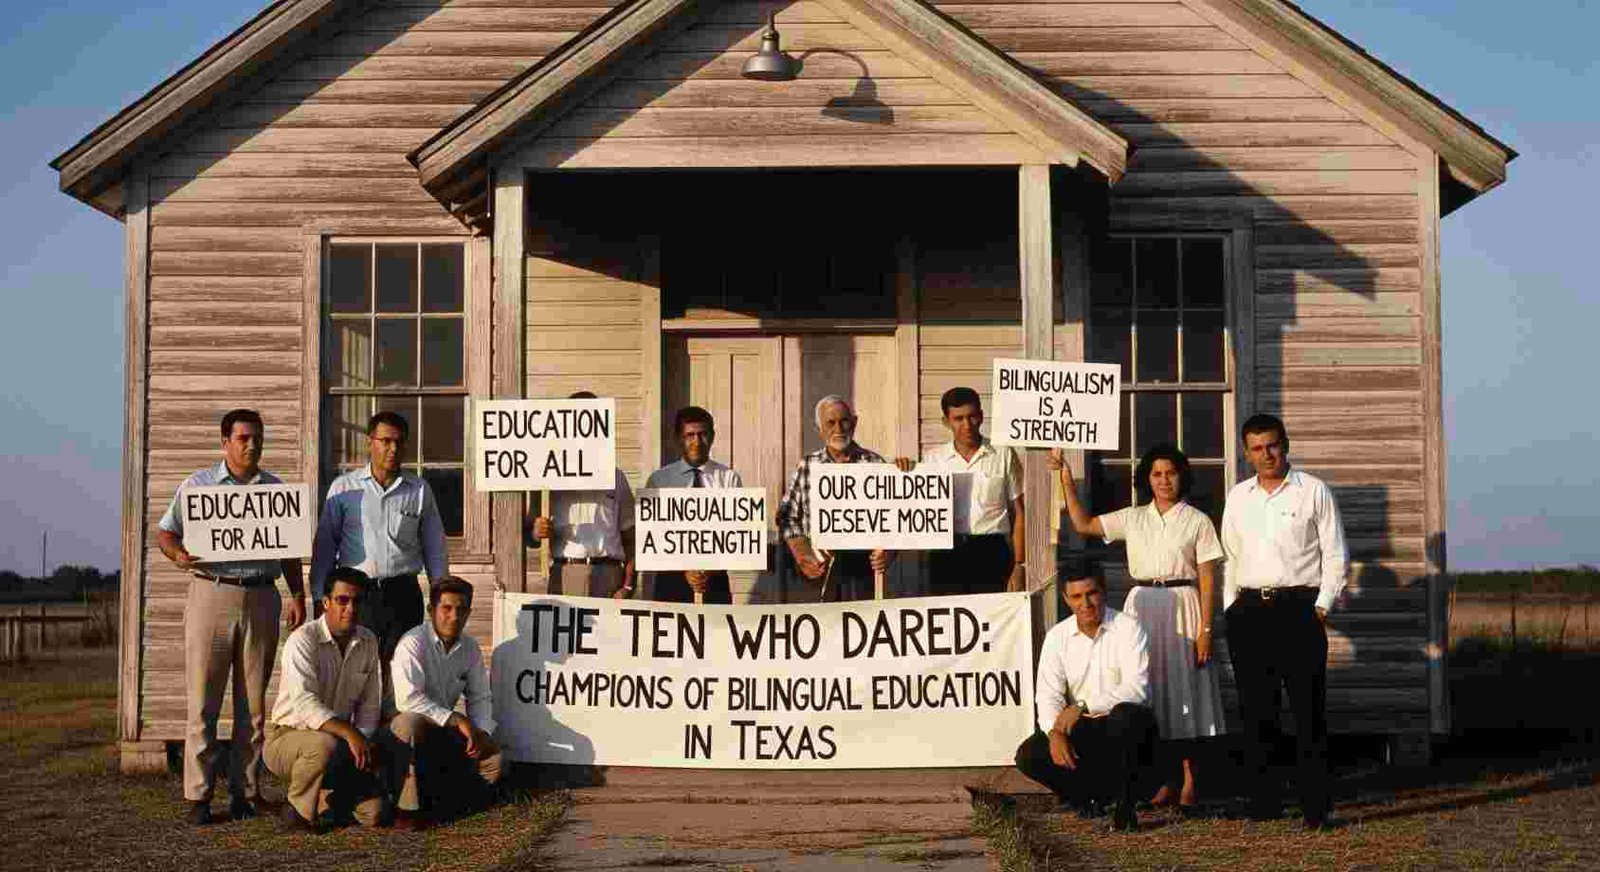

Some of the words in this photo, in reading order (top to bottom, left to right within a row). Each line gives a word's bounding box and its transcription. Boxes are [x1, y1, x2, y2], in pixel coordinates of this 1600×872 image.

[1000, 369, 1114, 394] BILINGUALISM
[1039, 397, 1053, 416] IS
[1060, 399, 1072, 417] A
[483, 409, 608, 439] EDUCATION
[1010, 419, 1097, 443] STRENGTH
[485, 450, 529, 478] FOR
[543, 450, 592, 477] ALL
[819, 476, 857, 500] OUR
[864, 475, 949, 499] CHILDREN
[187, 491, 300, 521] EDUCATION
[640, 496, 764, 522] BILINGUALISM
[819, 509, 890, 533] DESEVE
[898, 508, 948, 533] MORE
[211, 528, 245, 551] FOR
[252, 526, 288, 549] ALL
[643, 531, 657, 553] A
[664, 530, 760, 554] STRENGTH
[521, 604, 599, 654] THE
[621, 609, 704, 659] TEN
[726, 614, 820, 660] WHO
[842, 608, 990, 658] DARED:
[515, 669, 672, 708] CHAMPIONS
[684, 677, 718, 710] OF
[728, 677, 862, 711] BILINGUAL
[872, 671, 1021, 710] EDUCATION
[685, 725, 712, 759] IN
[731, 720, 836, 760] TEXAS
